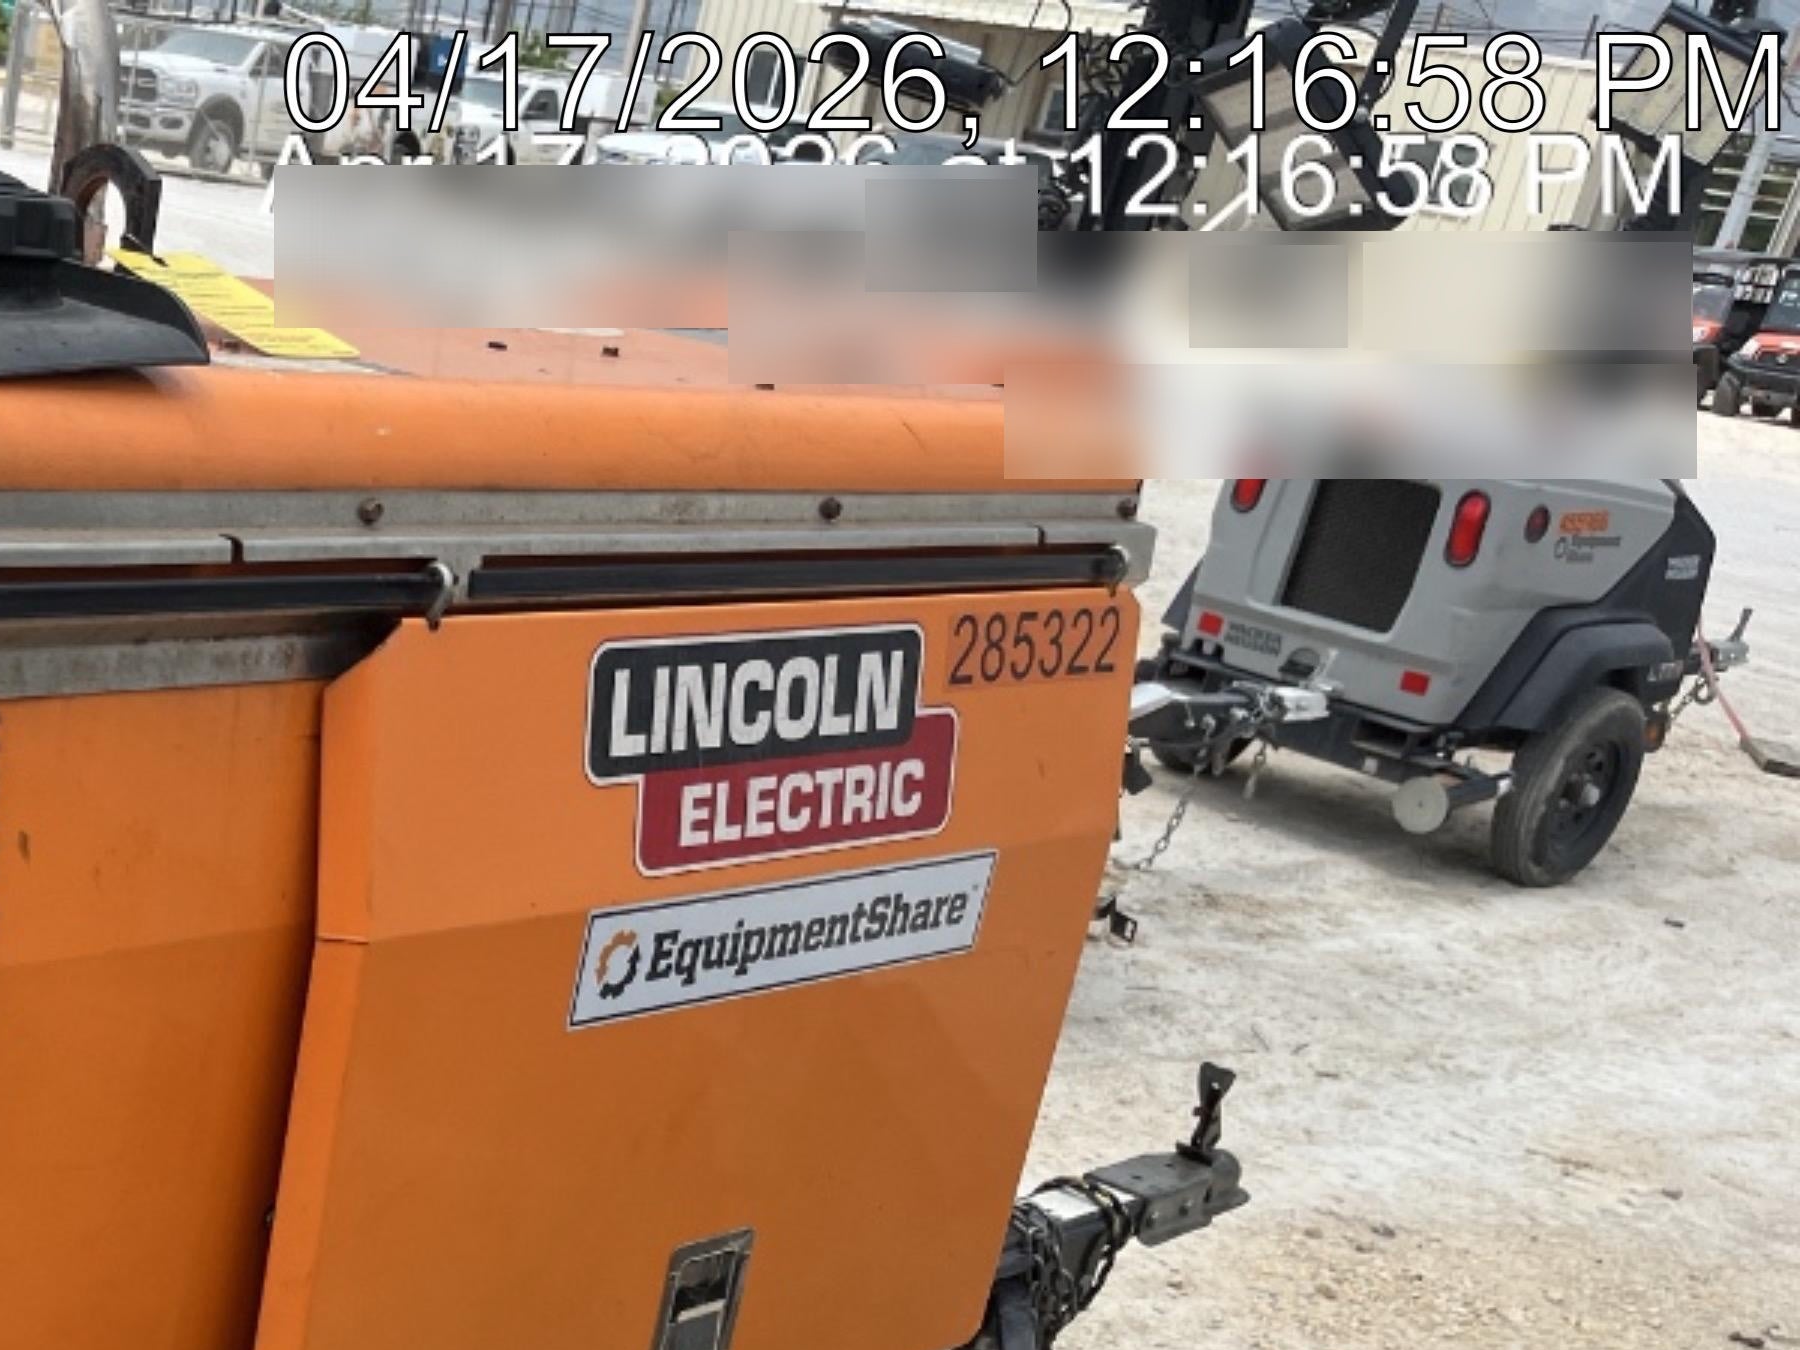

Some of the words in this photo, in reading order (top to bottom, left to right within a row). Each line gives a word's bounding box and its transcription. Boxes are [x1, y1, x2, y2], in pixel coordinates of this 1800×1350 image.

[948, 605, 1122, 686] 285322
[609, 649, 906, 759] LINCOLN
[678, 757, 926, 848] ELECTRIC
[646, 890, 968, 987] EquipmentShare
